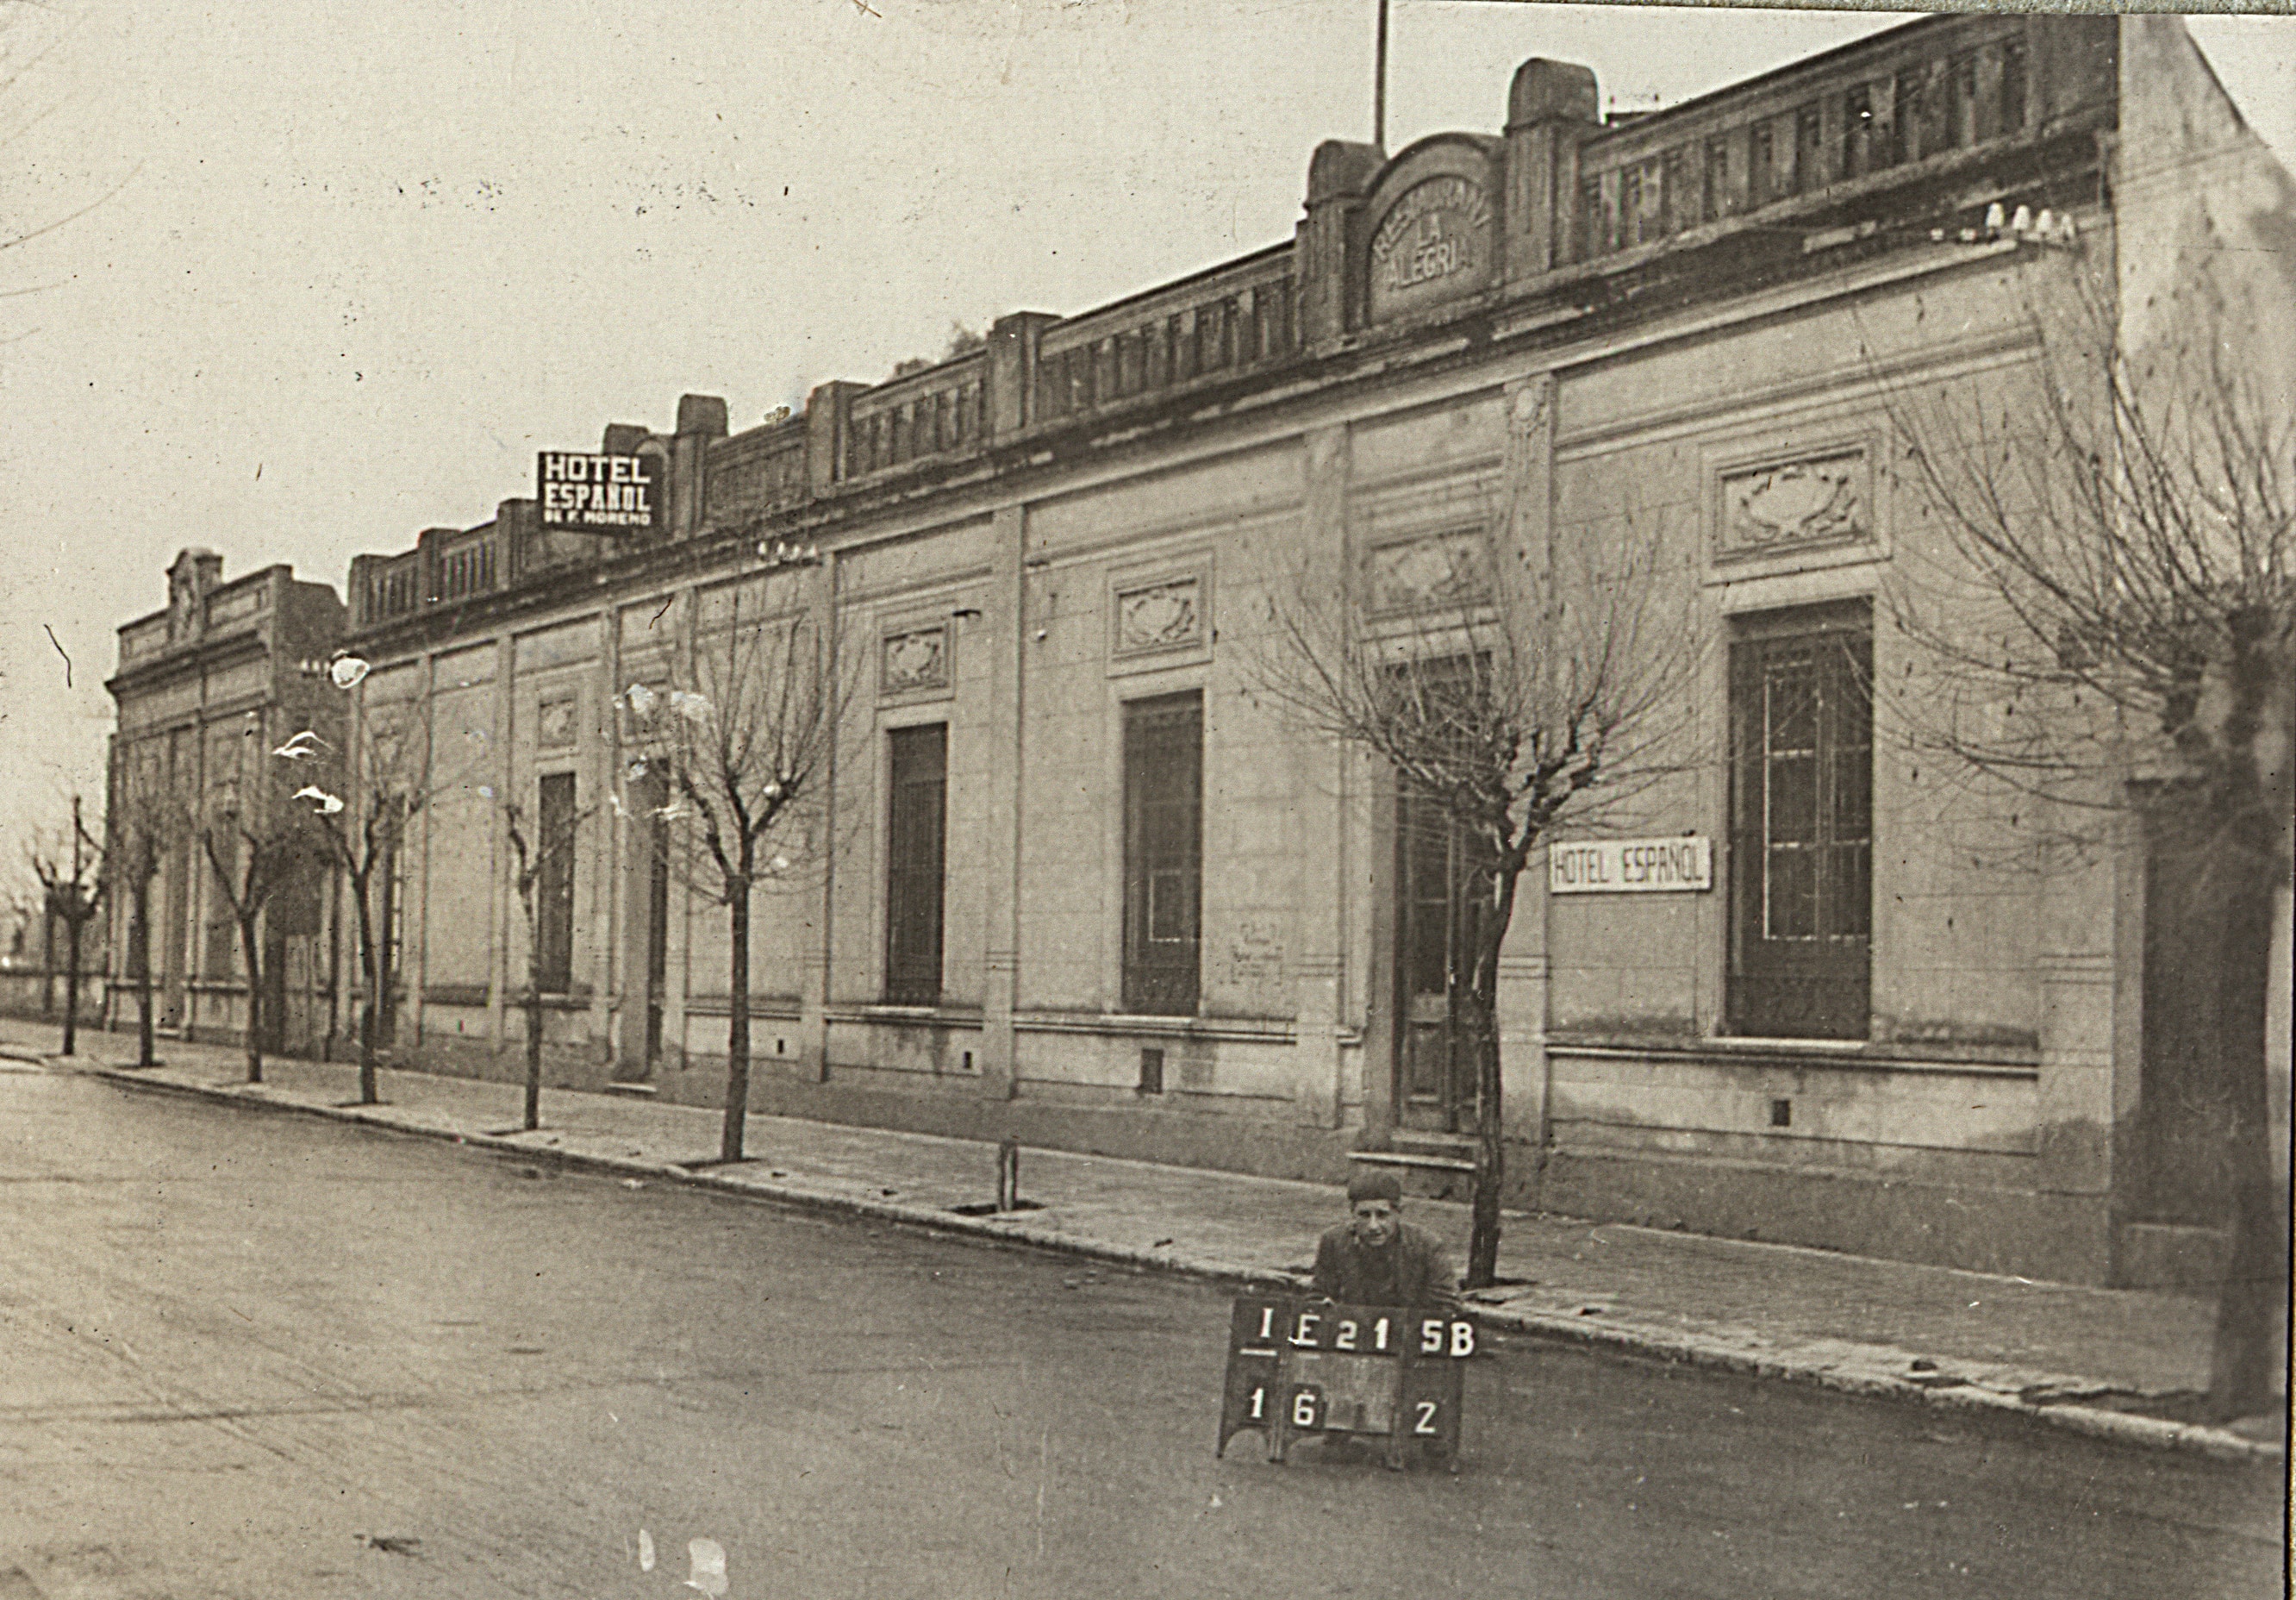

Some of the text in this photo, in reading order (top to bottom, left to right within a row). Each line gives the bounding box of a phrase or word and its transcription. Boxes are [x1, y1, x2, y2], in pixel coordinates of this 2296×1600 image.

[546, 454, 652, 484] HOTEL
[583, 510, 652, 526] MORENO
[1555, 848, 1609, 884] HOTEL
